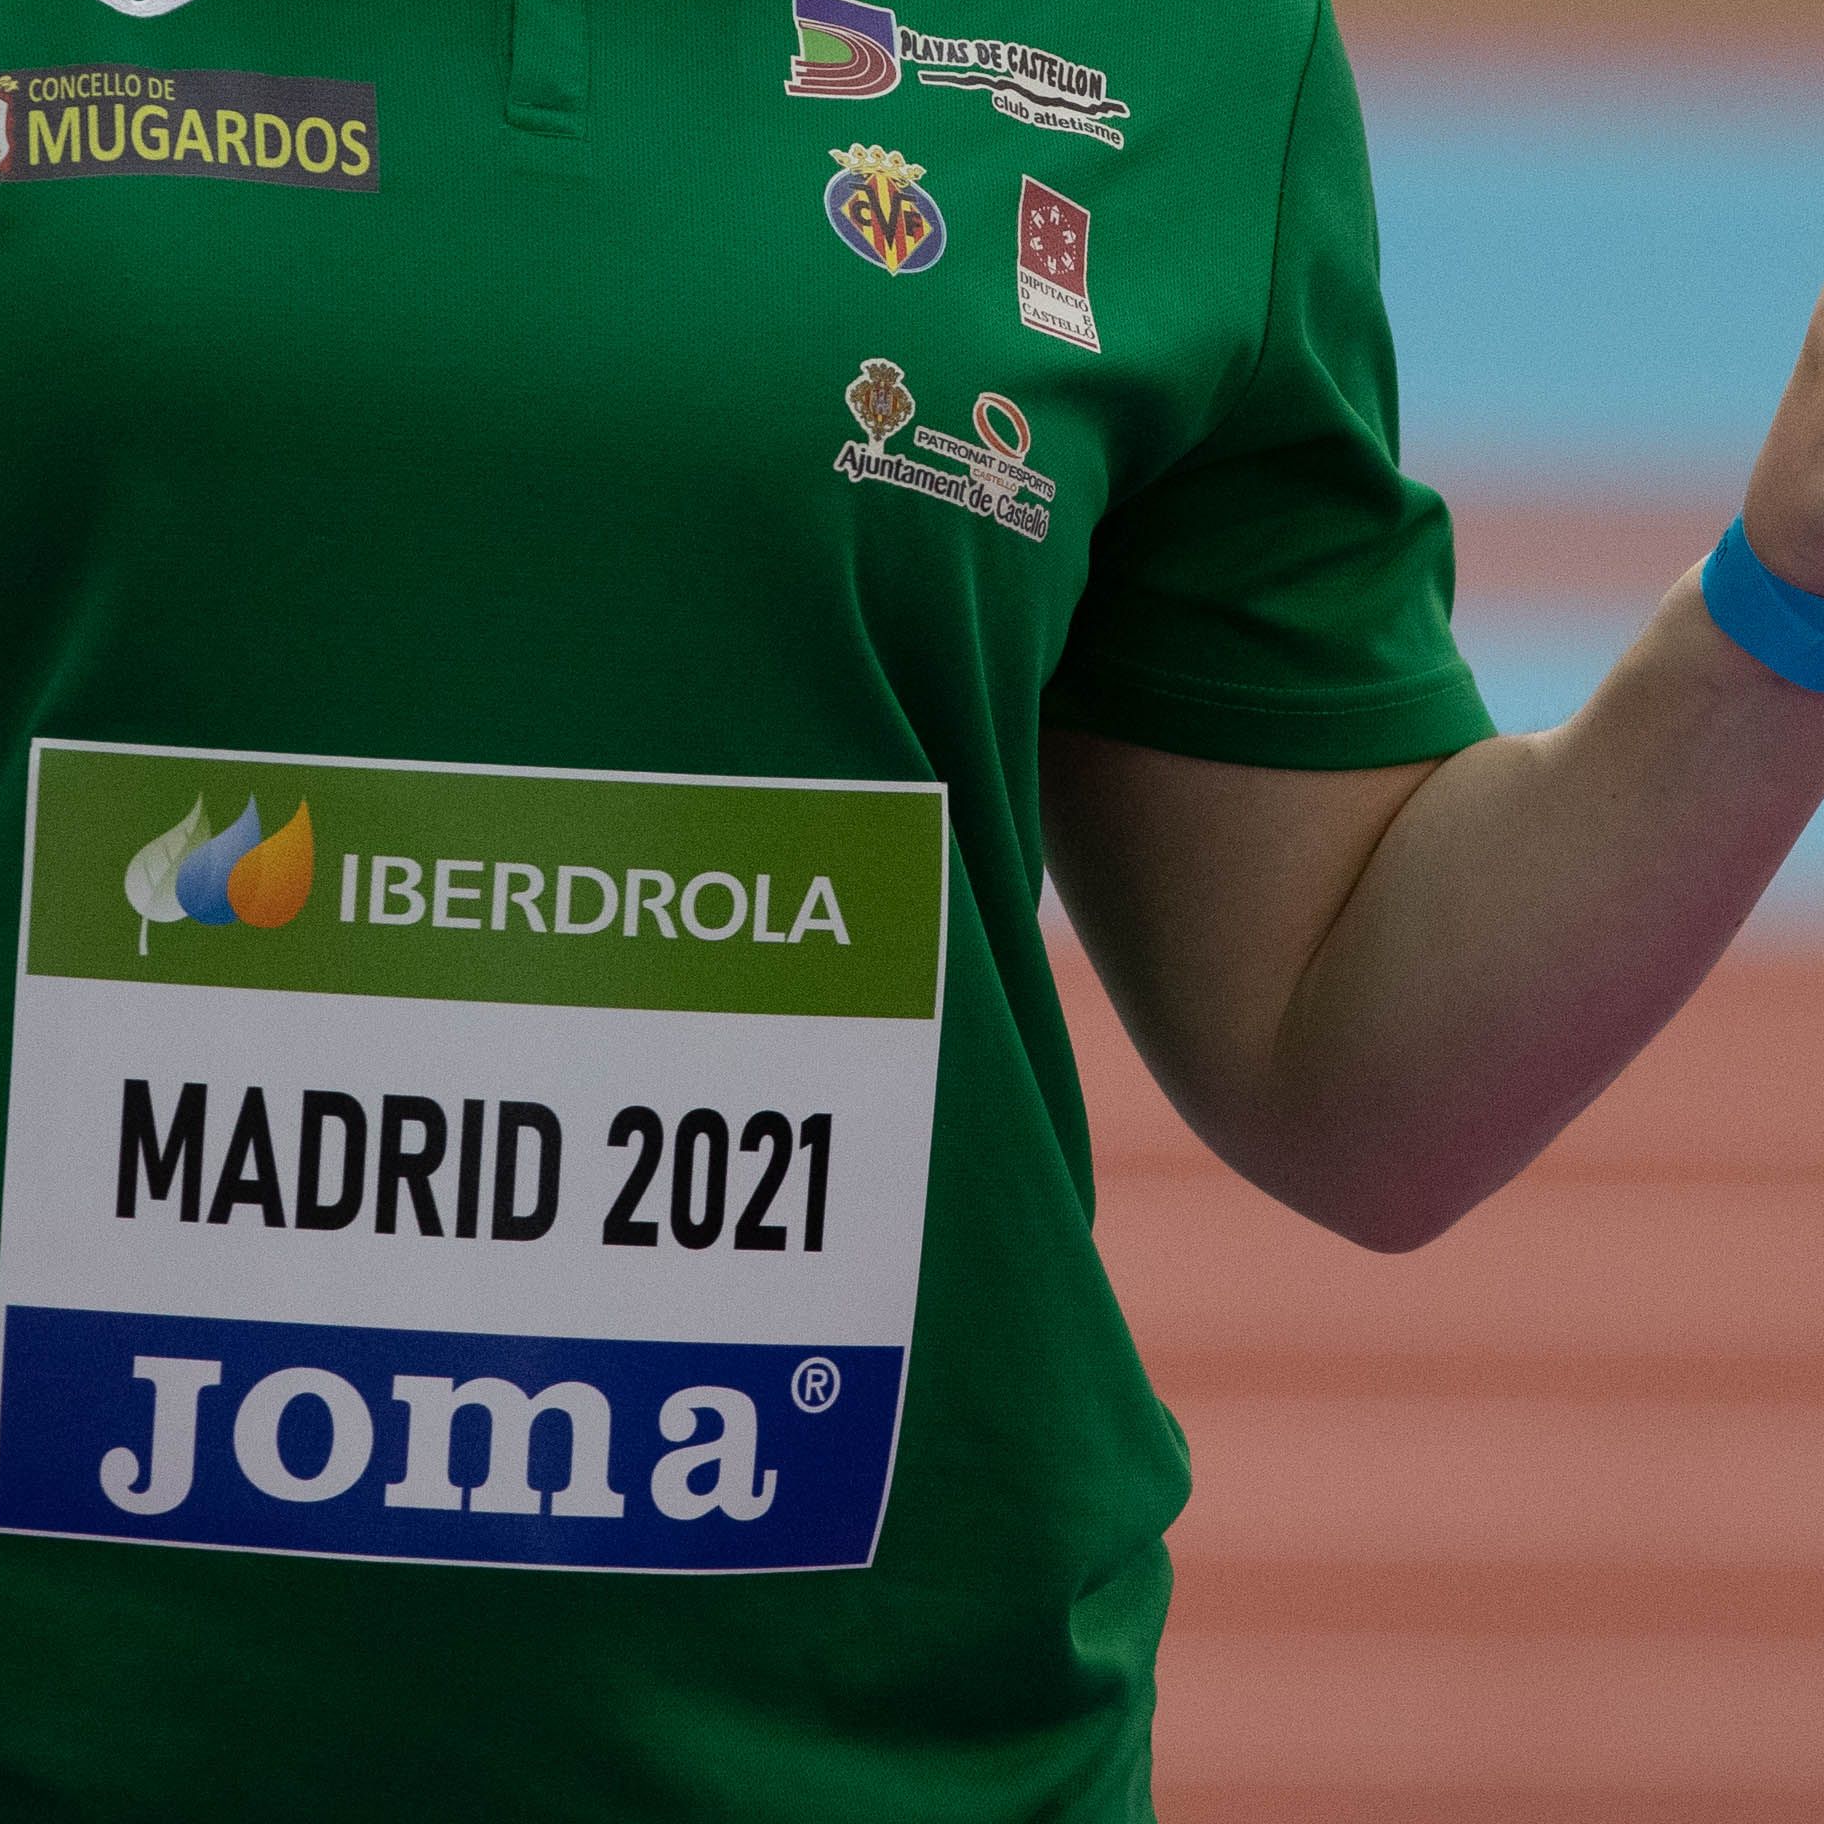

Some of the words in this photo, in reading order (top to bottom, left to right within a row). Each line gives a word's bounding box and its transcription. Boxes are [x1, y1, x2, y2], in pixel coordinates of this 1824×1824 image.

[28, 74, 141, 103] CONCELLO
[148, 77, 176, 102] DE
[900, 29, 969, 64] PLAYAS
[976, 44, 1002, 68] DE
[1007, 45, 1103, 101] CASTELLON
[27, 104, 371, 176] MUGARDOS
[993, 93, 1030, 120] club
[1033, 110, 1122, 145] atletisme
[1019, 271, 1089, 312] DIPUTACIÓ
[837, 445, 967, 502] Ajuntament
[968, 483, 993, 513] de
[996, 494, 1049, 539] Castelló
[917, 429, 996, 469] PATRONAT
[997, 459, 1055, 499] D'ESPORTS
[339, 852, 851, 946] IBERDROLA
[114, 1078, 564, 1242] MADRID
[601, 1104, 833, 1253] 2021
